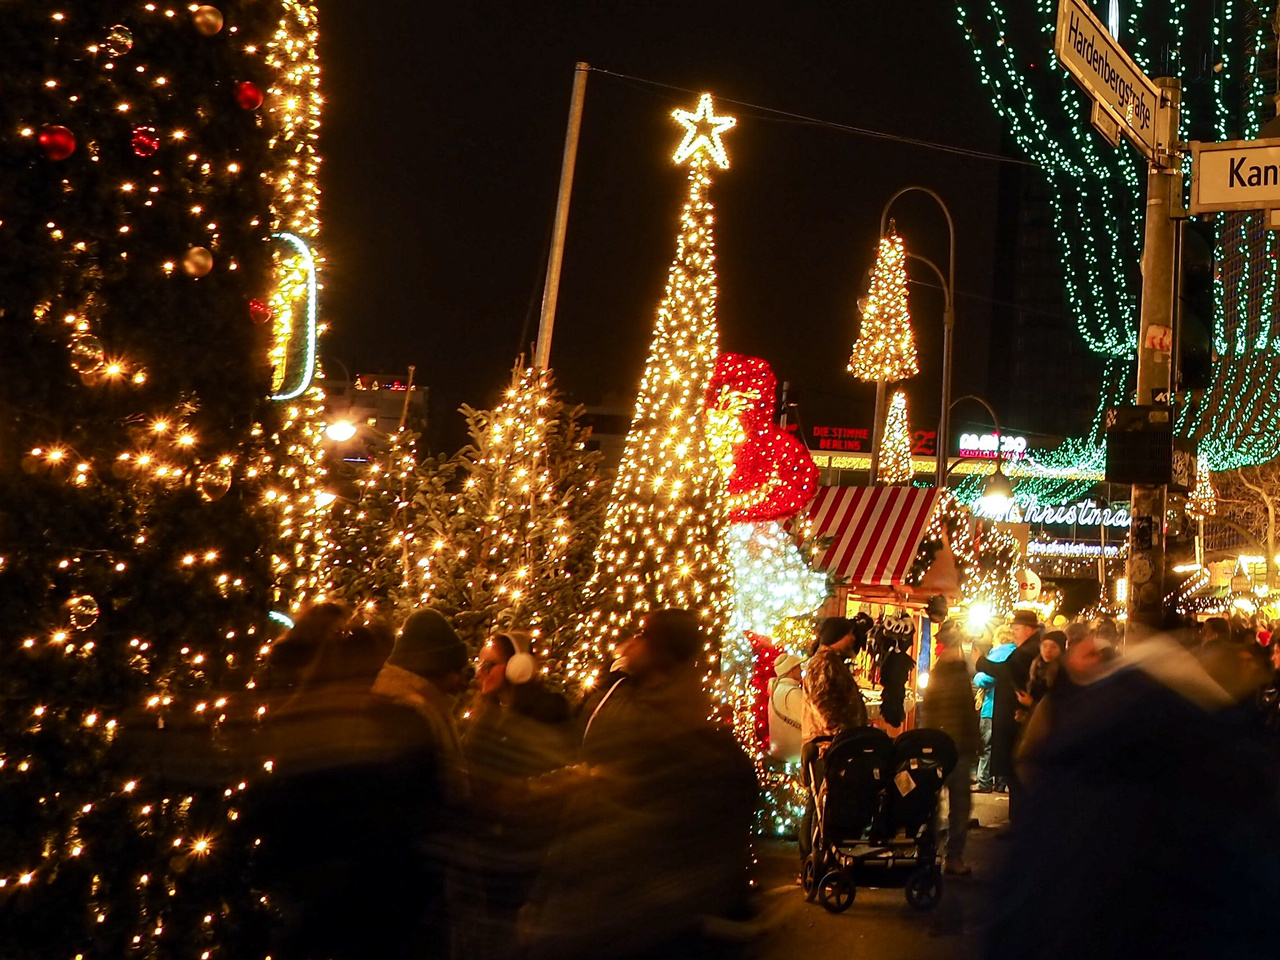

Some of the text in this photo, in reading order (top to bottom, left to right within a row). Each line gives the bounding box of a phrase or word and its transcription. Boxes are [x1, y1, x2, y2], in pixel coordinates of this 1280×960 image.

[1068, 10, 1151, 130] Hardenbergstraße
[813, 426, 869, 440] DIE STIMME
[819, 438, 861, 451] BERLINS
